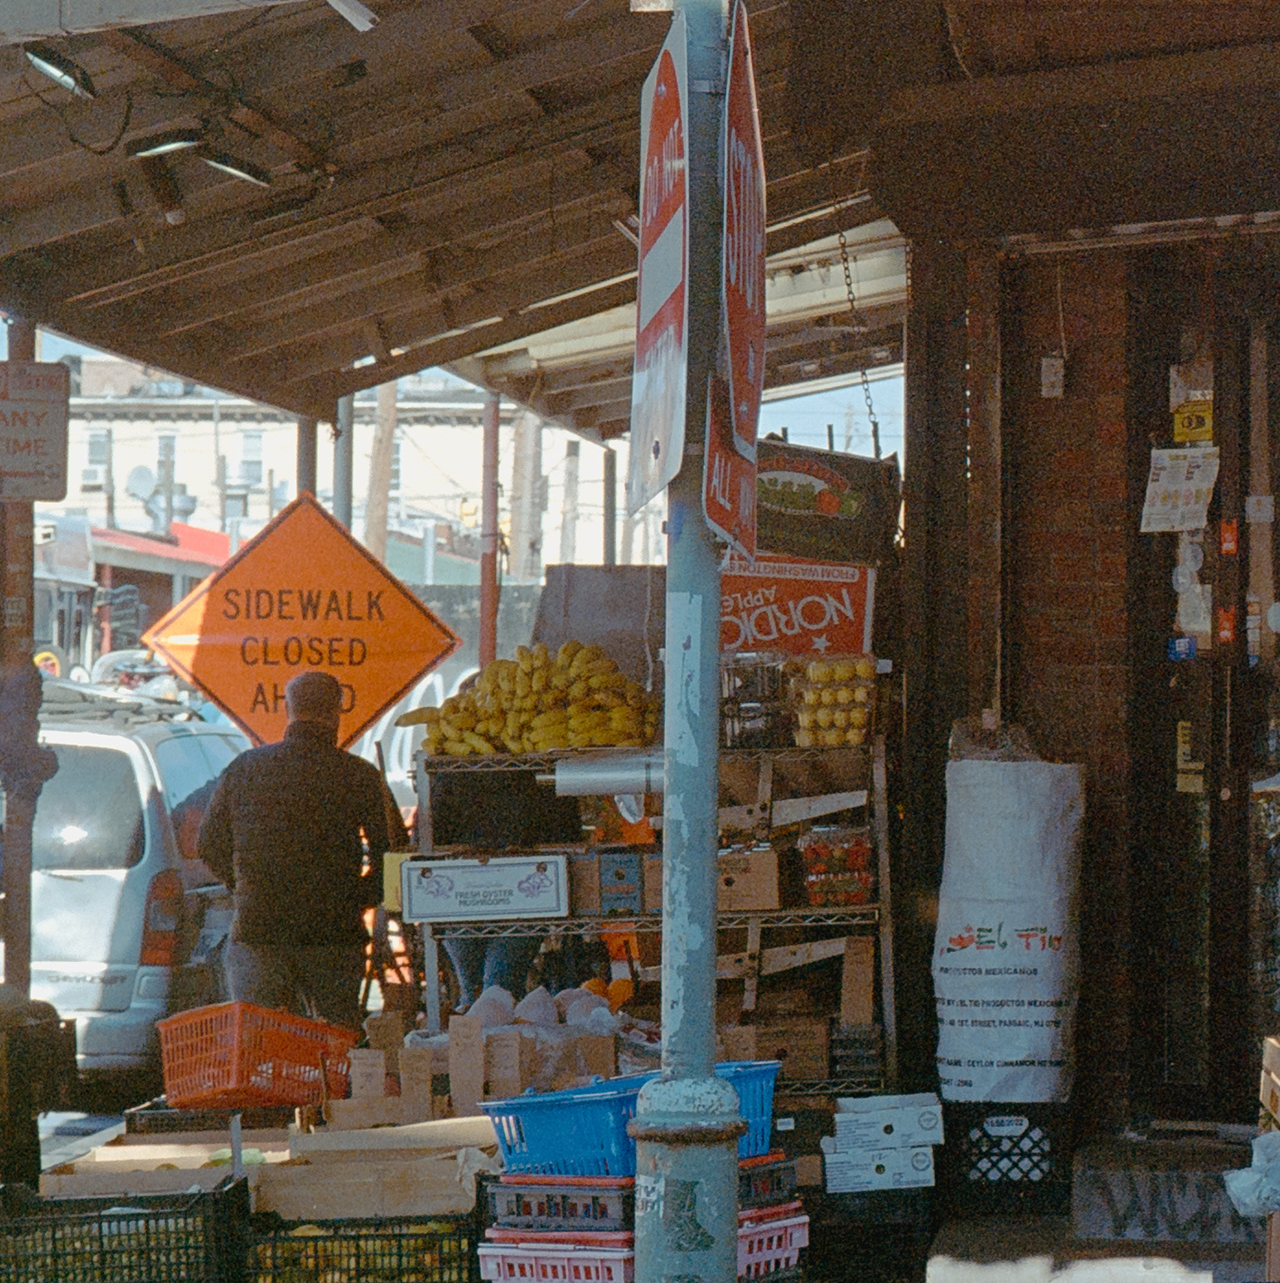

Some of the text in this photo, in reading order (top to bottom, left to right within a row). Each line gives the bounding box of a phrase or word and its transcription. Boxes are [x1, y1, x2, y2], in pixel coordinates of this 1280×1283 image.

[0, 438, 49, 456] IME
[710, 451, 731, 511] ALL
[820, 568, 856, 581] FROM
[222, 589, 385, 621] SIDEWALK
[722, 588, 854, 650] NORDIC
[241, 636, 367, 666] CLOSED
[251, 683, 356, 714] AHD
